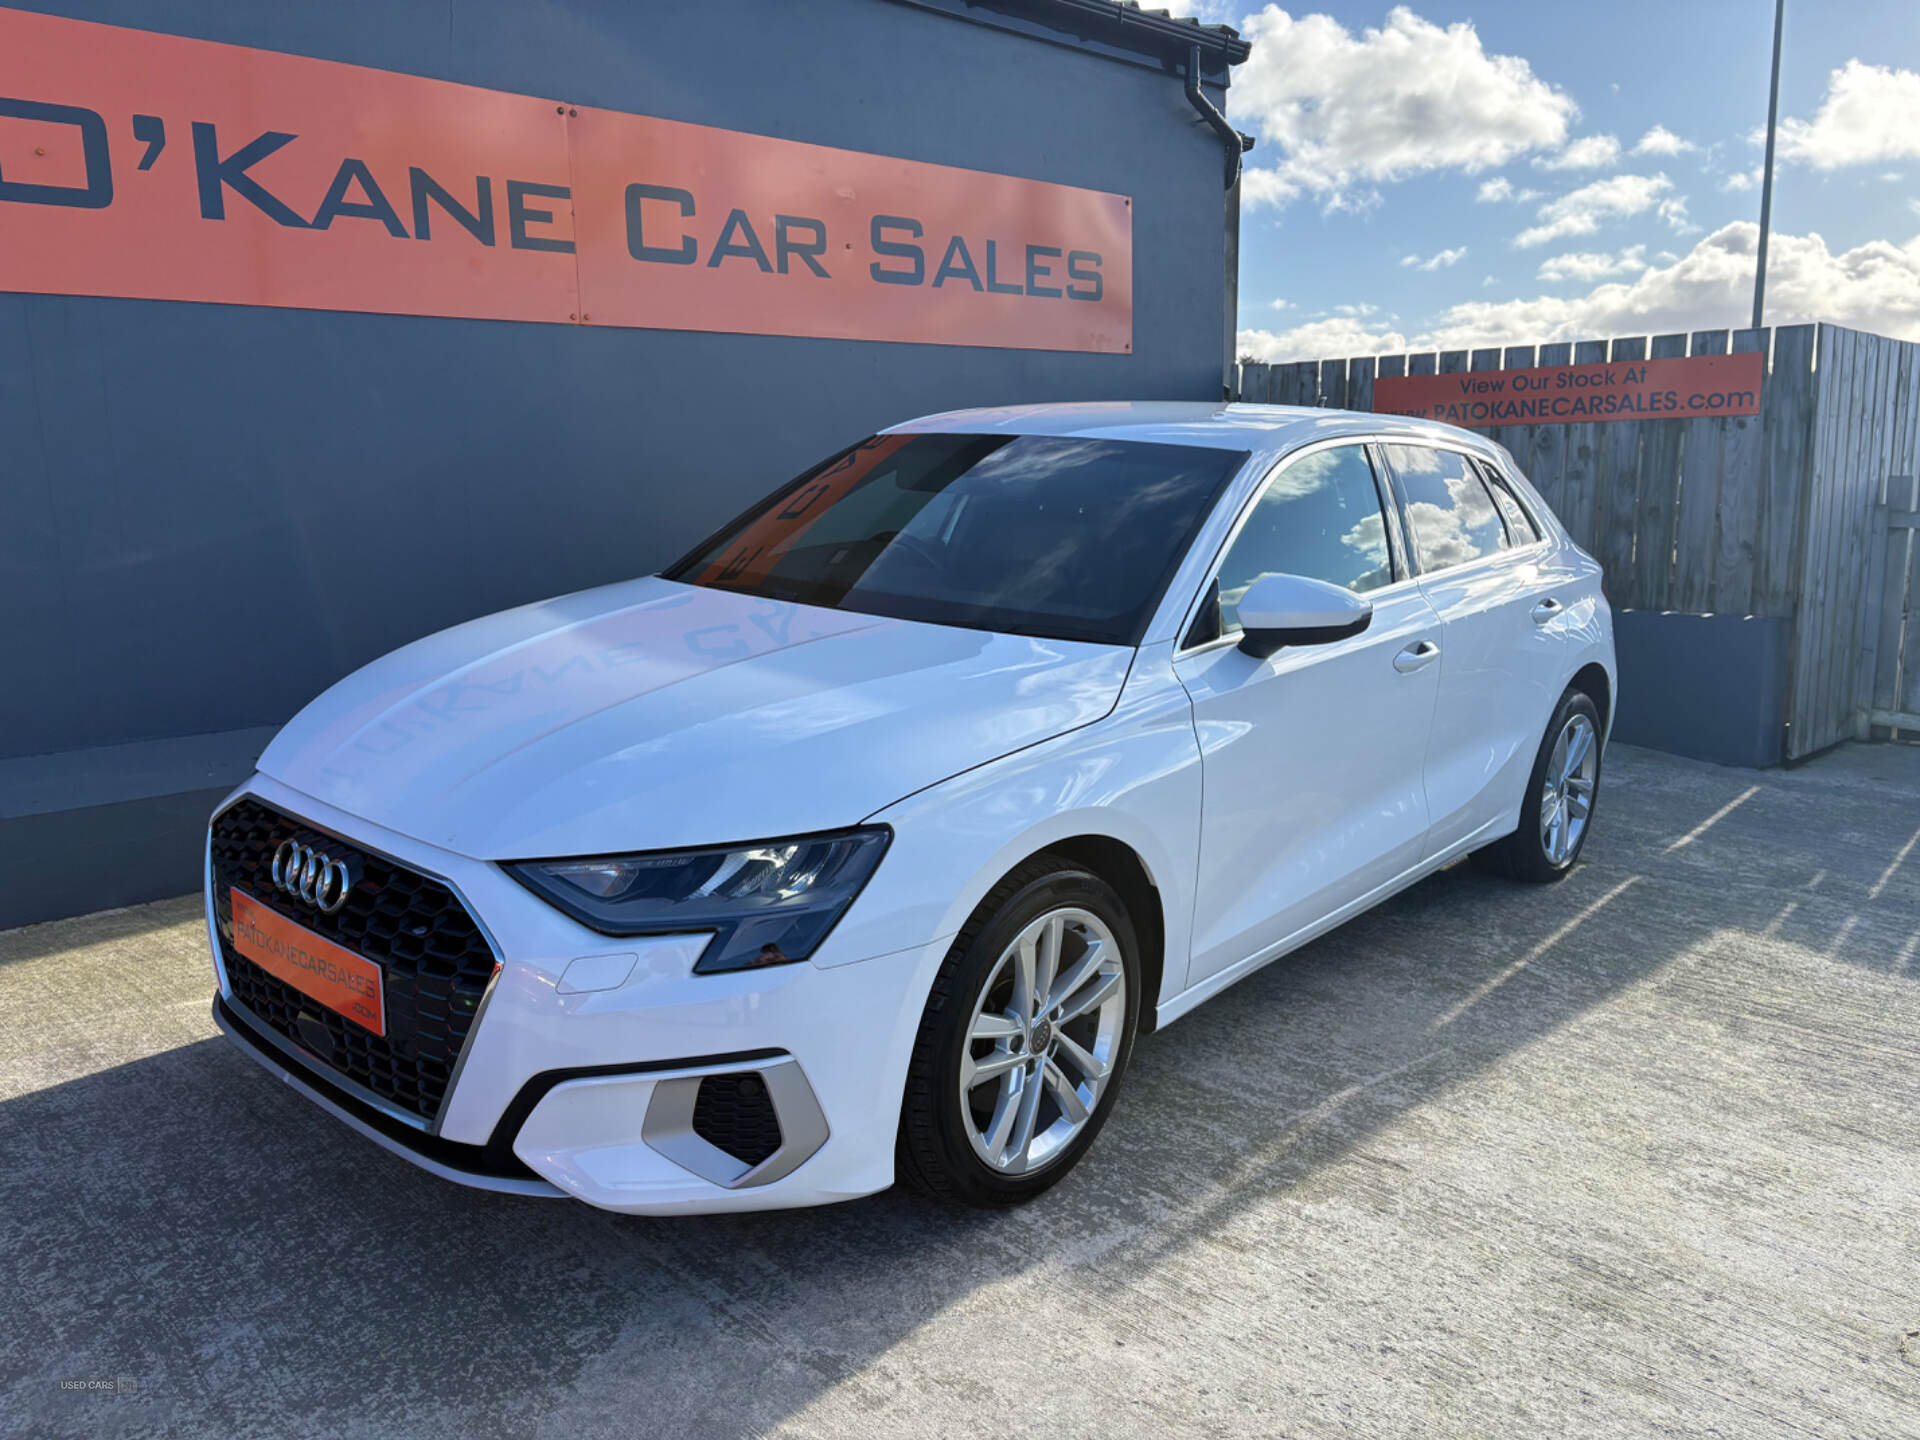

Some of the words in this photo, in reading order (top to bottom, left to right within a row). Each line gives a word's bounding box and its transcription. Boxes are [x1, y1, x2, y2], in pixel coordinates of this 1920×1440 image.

[869, 214, 1104, 302] SALES
[1460, 378, 1505, 395] View
[1512, 375, 1550, 392] Our
[1556, 370, 1616, 389] Stock
[1622, 366, 1647, 385] At
[236, 921, 376, 1000] PATOKANECARSALES
